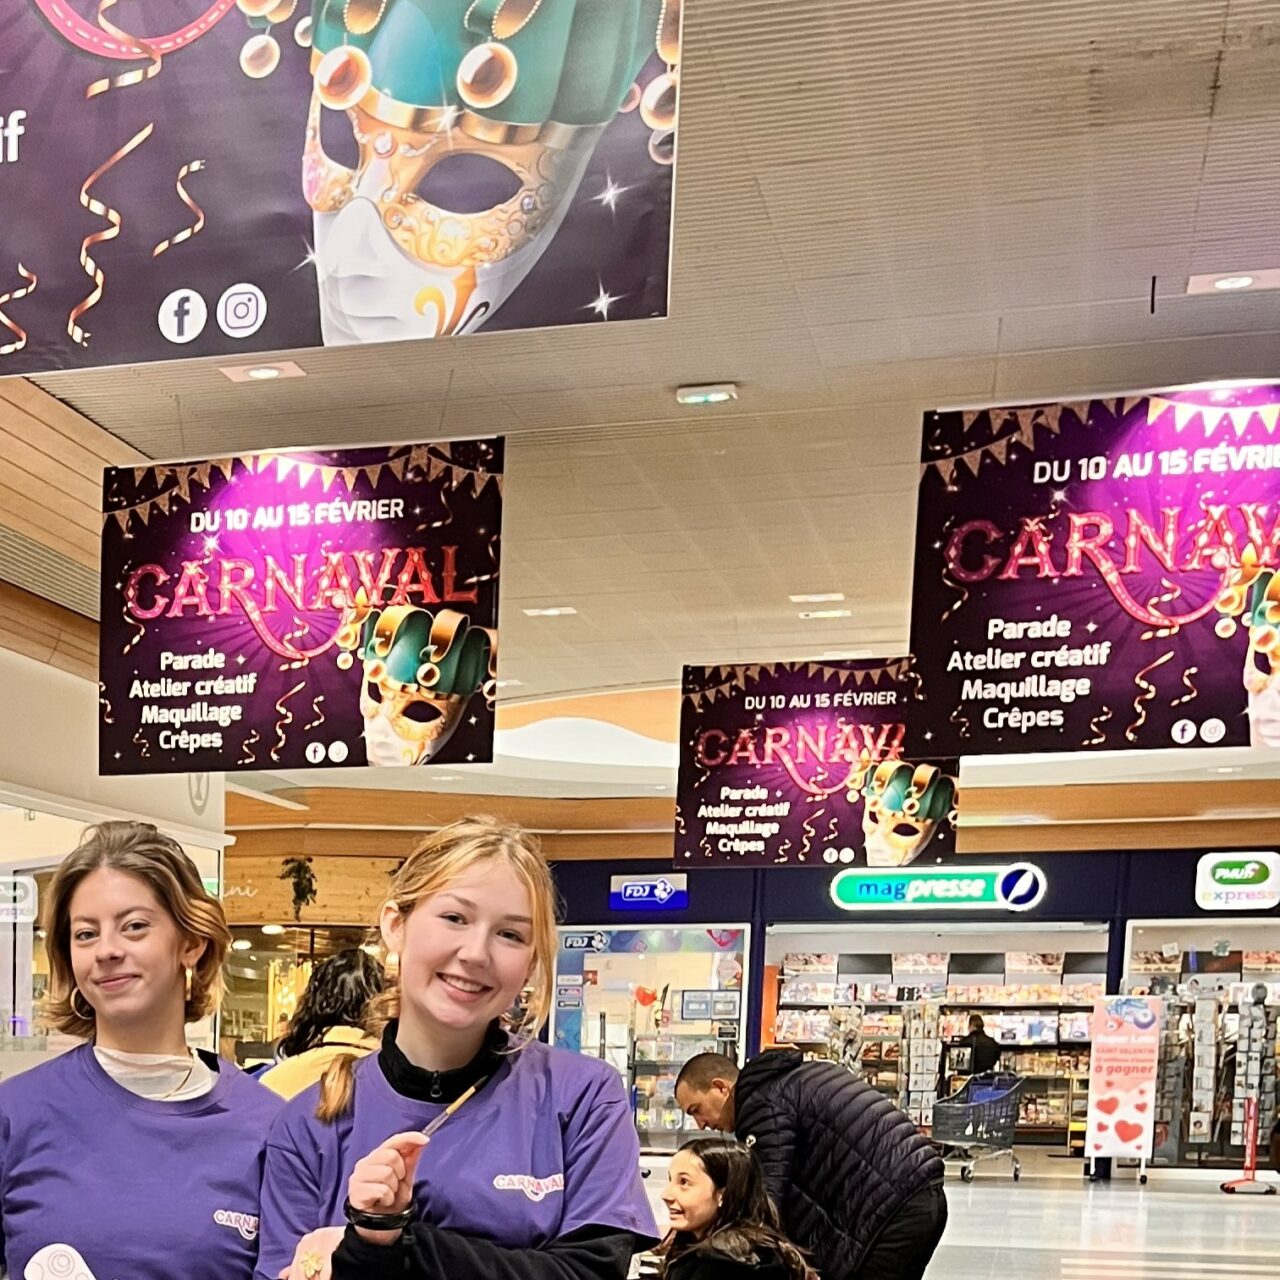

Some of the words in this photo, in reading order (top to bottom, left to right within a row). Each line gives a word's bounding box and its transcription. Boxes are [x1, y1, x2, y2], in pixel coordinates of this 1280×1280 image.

[1033, 460, 1071, 485] DU
[1078, 458, 1107, 480] 10
[1113, 451, 1154, 477] AU
[1159, 450, 1188, 476] 15
[190, 508, 220, 533] DU
[225, 507, 247, 531] 10
[252, 506, 284, 529] AU
[287, 504, 310, 528] 15
[315, 496, 404, 525] FÉVRIER
[123, 546, 477, 659] CARNAVAL
[988, 616, 1072, 640] Parade
[160, 648, 226, 672] Parade
[947, 649, 1026, 671] Atelier
[1031, 642, 1112, 668] créatif
[129, 678, 192, 700] Atelier
[195, 672, 257, 696] créatif
[961, 676, 1092, 704] Maquillage
[745, 695, 767, 710] DU
[770, 694, 786, 709] 10
[789, 693, 812, 708] AU
[814, 693, 830, 707] 15
[833, 688, 897, 707] FÉVRIER
[141, 703, 242, 730] Maquillage
[982, 707, 1065, 734] Crêpes
[158, 730, 223, 754] Crêpes
[720, 785, 769, 800] Parade
[697, 803, 743, 818] Atelier
[745, 801, 791, 817] créatif
[706, 820, 780, 838] Maquillage
[718, 838, 765, 855] Crêpes
[625, 885, 650, 898] FDJ
[1201, 890, 1277, 904] express
[565, 936, 588, 948] FDJ
[1106, 1065, 1154, 1076] gagner
